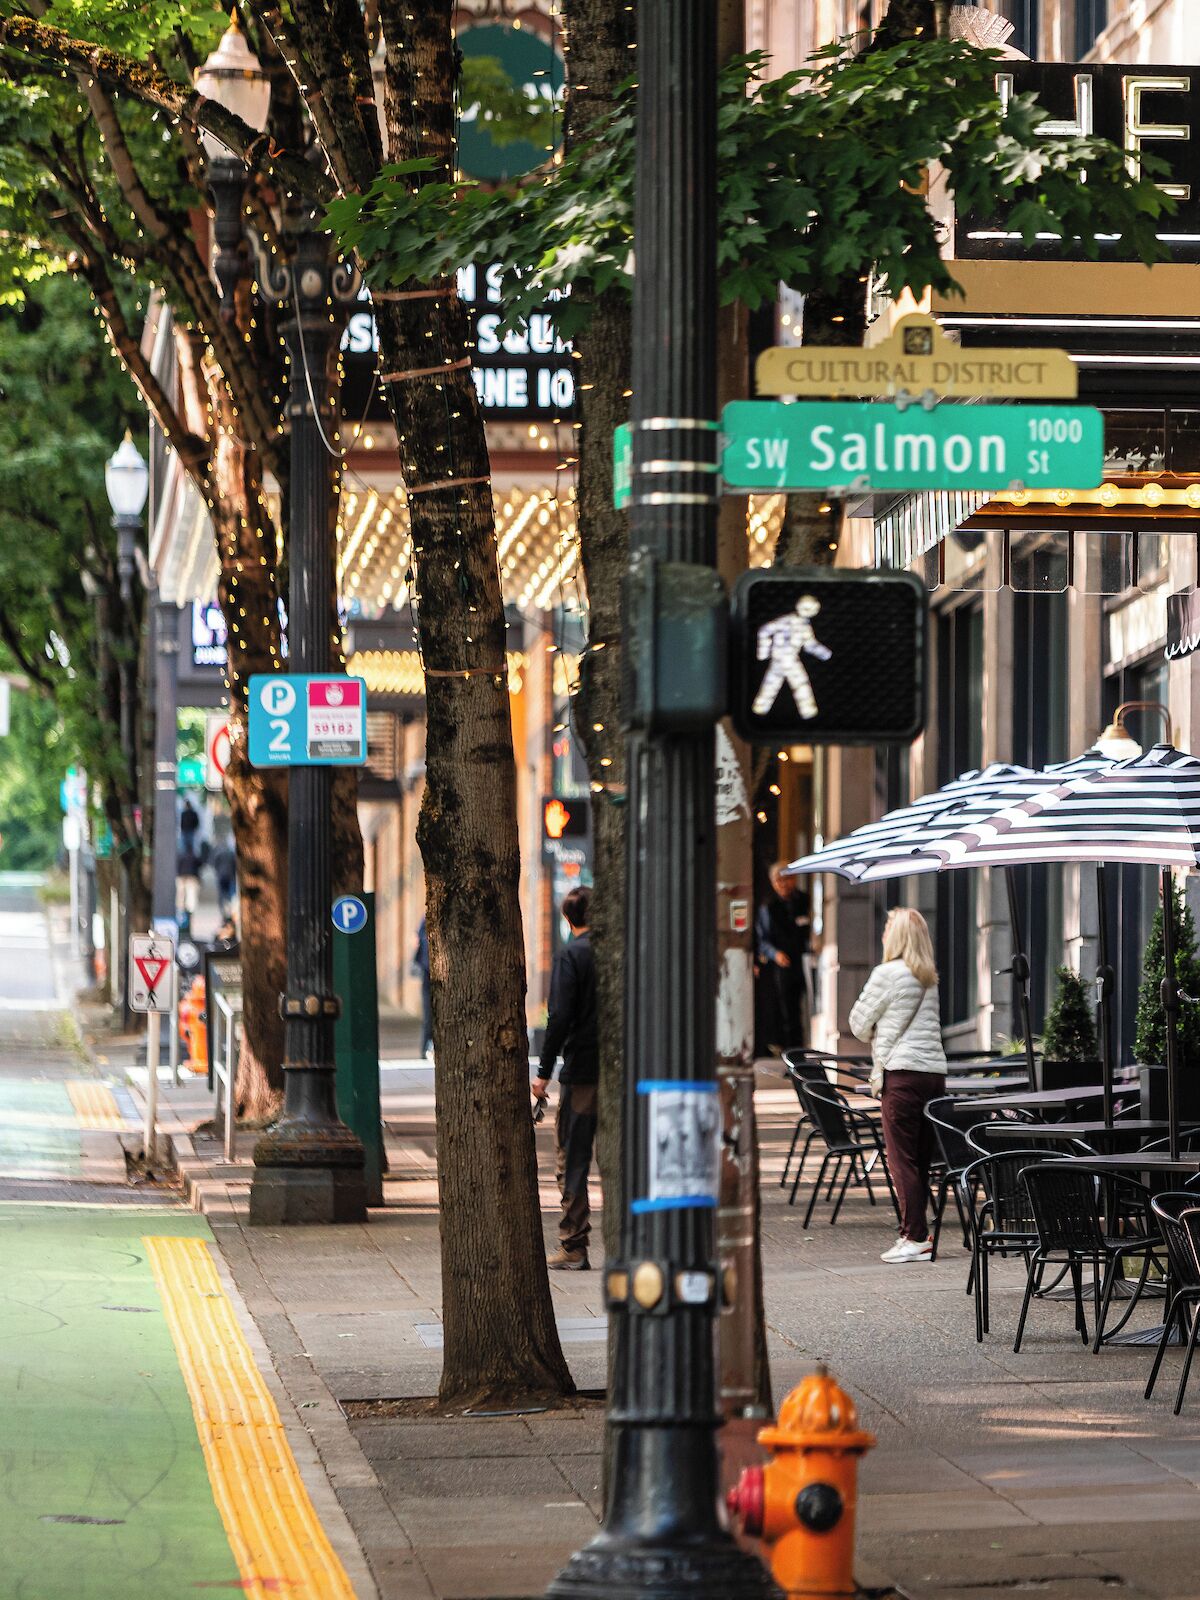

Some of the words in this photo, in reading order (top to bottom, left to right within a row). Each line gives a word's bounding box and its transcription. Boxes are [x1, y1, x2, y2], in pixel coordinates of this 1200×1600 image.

[786, 360, 920, 384] CULTURAL
[932, 361, 1048, 385] DISTRICT
[1027, 418, 1083, 444] 1000
[746, 437, 789, 470] SW
[809, 422, 1006, 473] Salmon
[1027, 450, 1051, 475] St
[272, 687, 288, 709] P
[269, 719, 291, 752] 2
[342, 901, 358, 928] P
